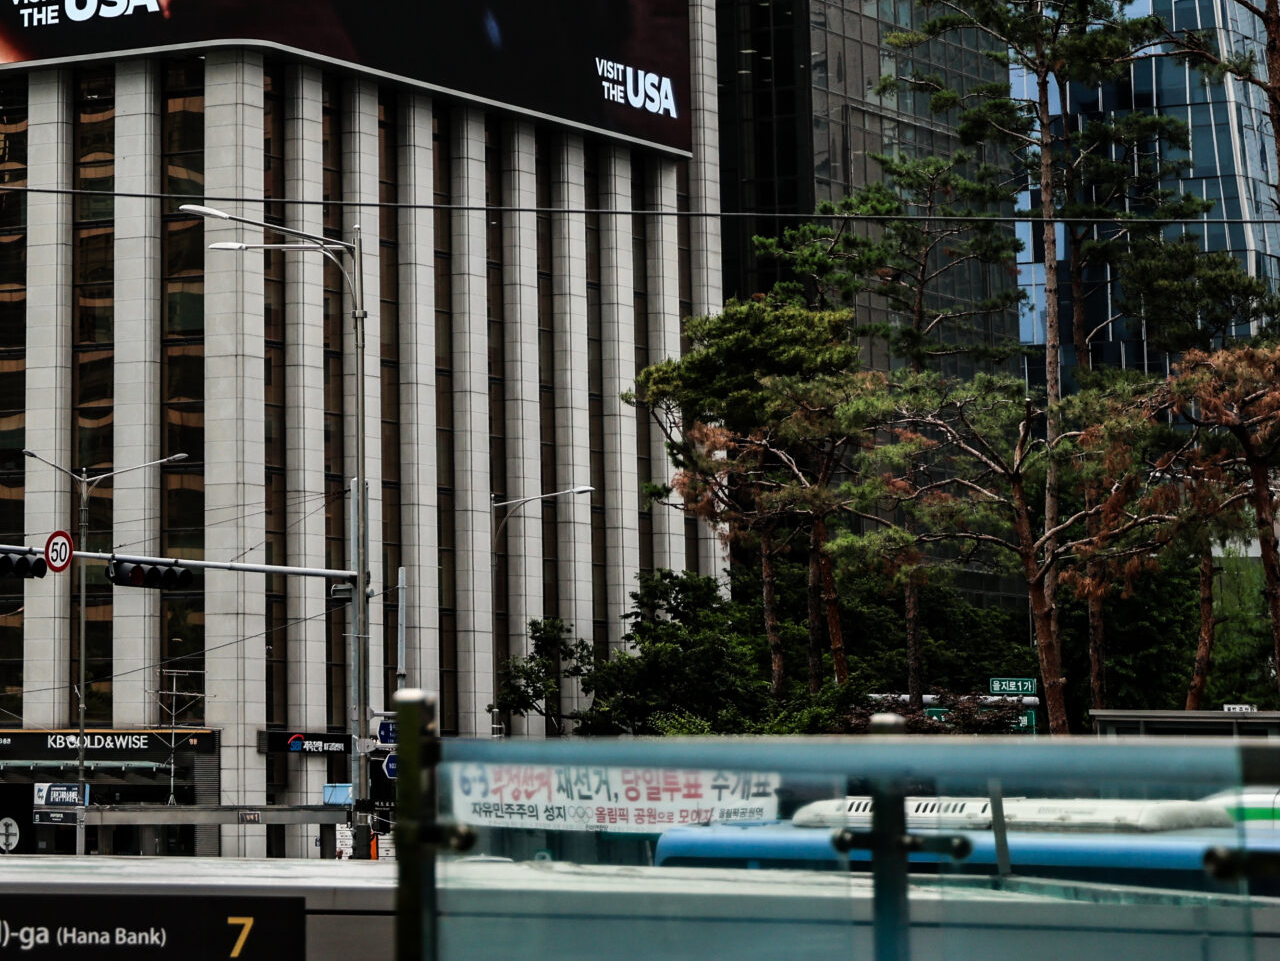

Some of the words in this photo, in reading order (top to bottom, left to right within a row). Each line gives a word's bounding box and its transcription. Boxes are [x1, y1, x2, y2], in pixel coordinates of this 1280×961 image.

[19, 5, 59, 28] THE
[595, 57, 625, 82] VISIT
[602, 80, 625, 104] THE
[626, 66, 678, 119] USA
[50, 541, 68, 563] 50
[992, 680, 1032, 692] 을지로1가
[622, 768, 703, 802] 당일투표
[471, 801, 539, 820] 자유민주주의
[543, 805, 567, 821] 성지
[594, 806, 629, 824] 올림픽
[633, 807, 674, 825] 공원으로
[56, 927, 109, 946] (Hana
[115, 927, 166, 946] Bank)
[227, 917, 254, 957] 7
